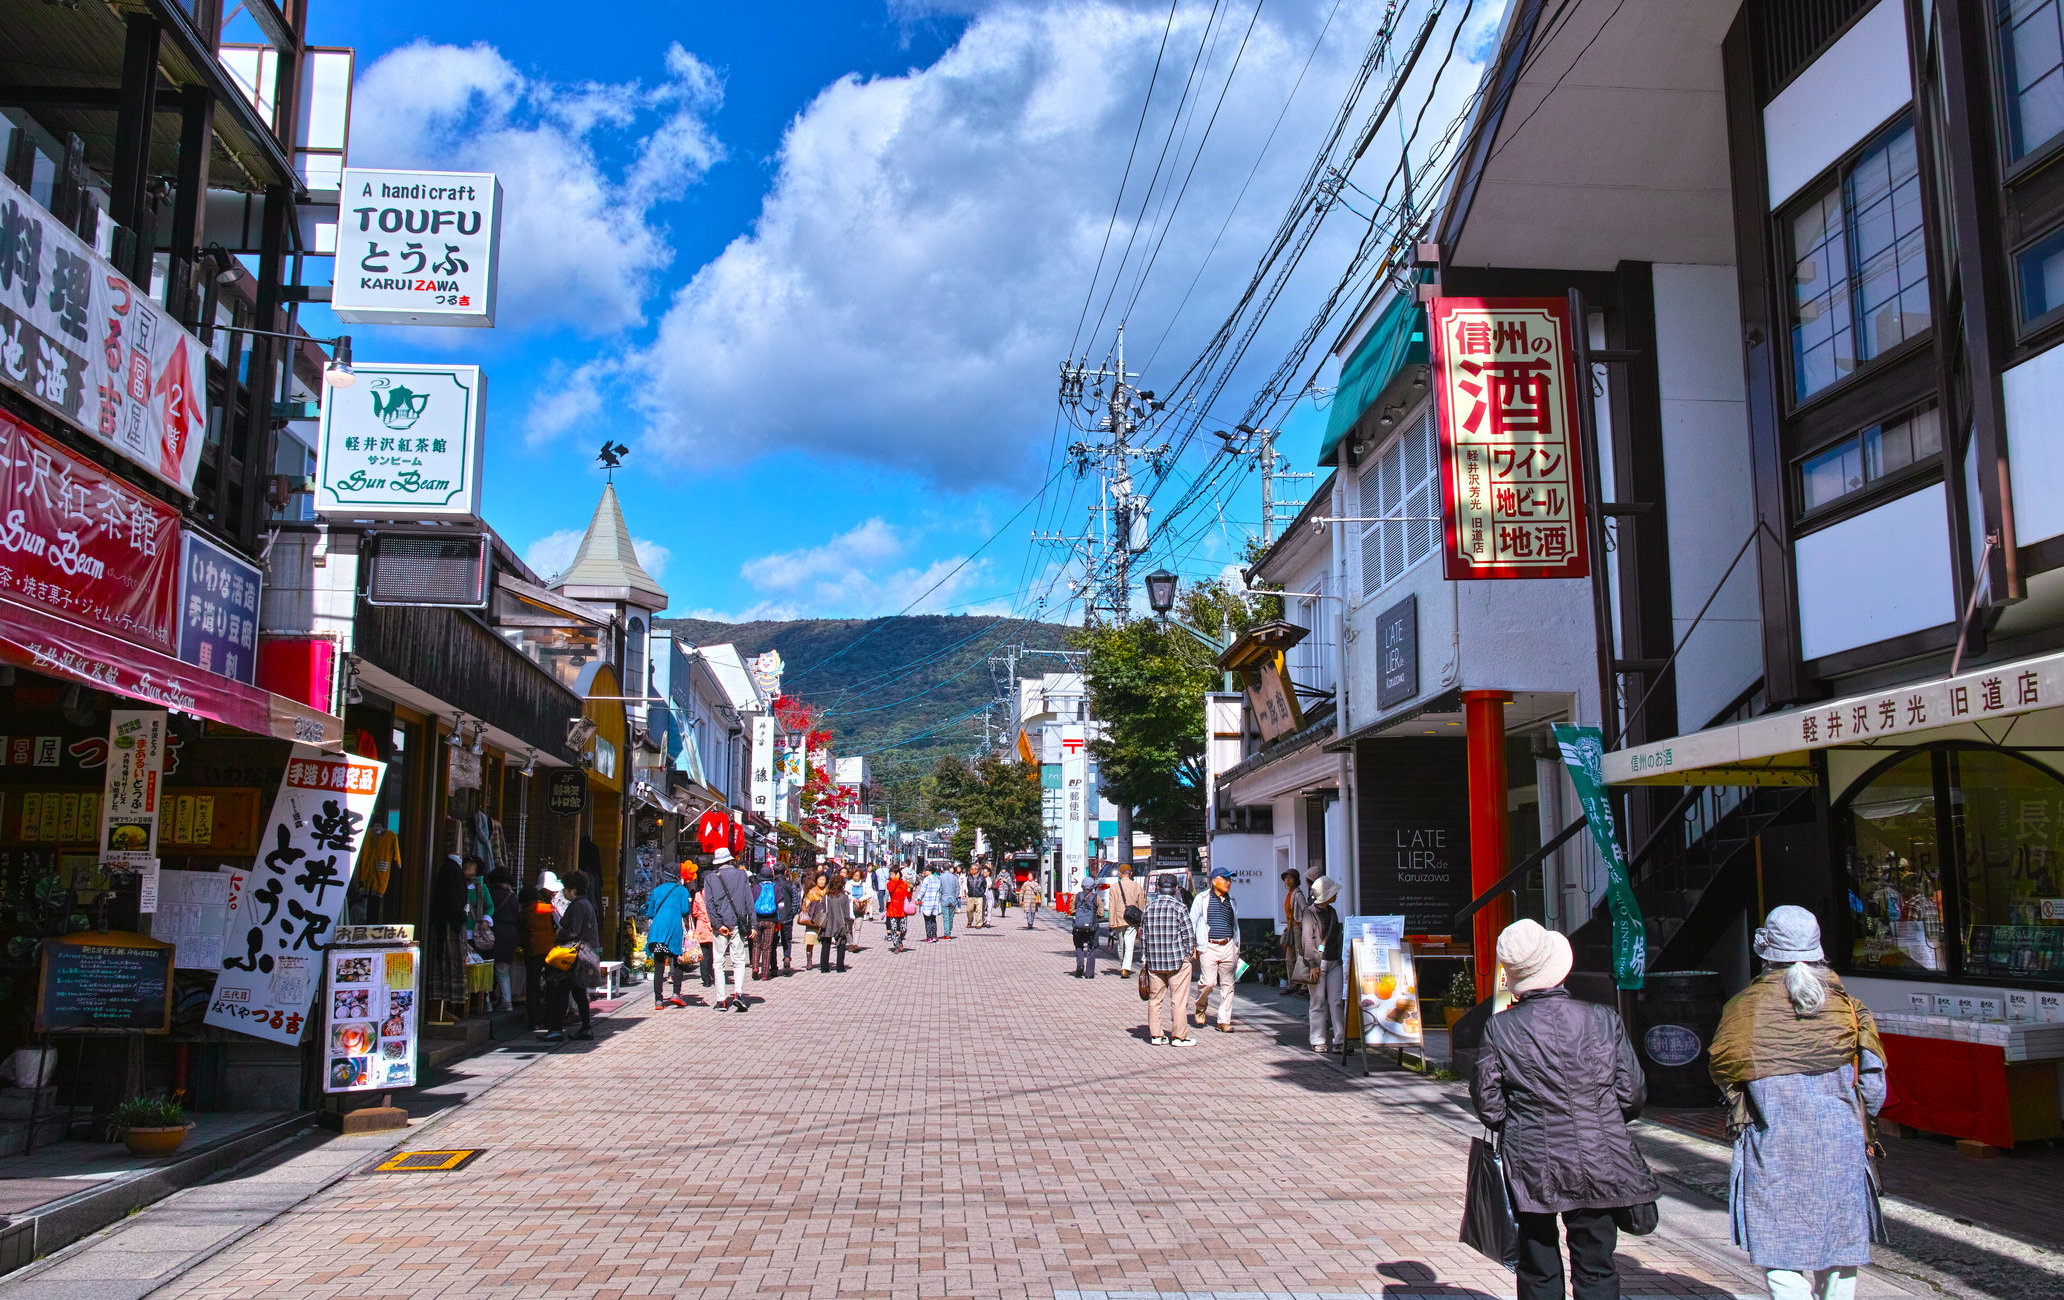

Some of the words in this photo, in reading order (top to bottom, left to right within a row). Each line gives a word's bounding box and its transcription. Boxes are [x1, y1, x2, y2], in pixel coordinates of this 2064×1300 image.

[362, 182, 372, 197] A
[381, 183, 476, 201] handicraft
[353, 207, 482, 236] TOUFU
[361, 241, 469, 276] とうふ
[360, 277, 460, 293] KARUIZAWA
[435, 295, 471, 307] つる吉
[1455, 320, 1553, 355] 信州の
[1458, 357, 1553, 435] 酒
[345, 436, 448, 453] 軽井沢紅茶館
[1494, 449, 1562, 479] ワイン
[337, 469, 387, 492] Sun
[389, 469, 450, 493] Beam
[1467, 450, 1482, 511] 軽井沢芳光
[1496, 487, 1565, 517] 地ビール
[0, 509, 46, 558] Sun
[48, 527, 105, 582] Beam
[1471, 517, 1484, 554] 旧道店
[1499, 525, 1567, 558] 地酒
[1802, 694, 1927, 744] 軽井沢芳光
[1949, 670, 2039, 717] 旧道店
[1631, 748, 1673, 772] 信州のお酒
[289, 763, 374, 791] 手造り限定品
[1069, 792, 1080, 822] 郵便局
[1397, 829, 1447, 848] L'ATE
[1072, 867, 1079, 876] P
[1398, 851, 1437, 870] LIER
[1436, 861, 1449, 870] de
[287, 799, 364, 952] 軽井沢
[1398, 872, 1450, 882] Karuizawa
[222, 823, 307, 975] とうふ
[336, 926, 408, 943] お昼ごはん
[222, 991, 247, 1002] 三代目
[251, 1007, 305, 1036] つる吉
